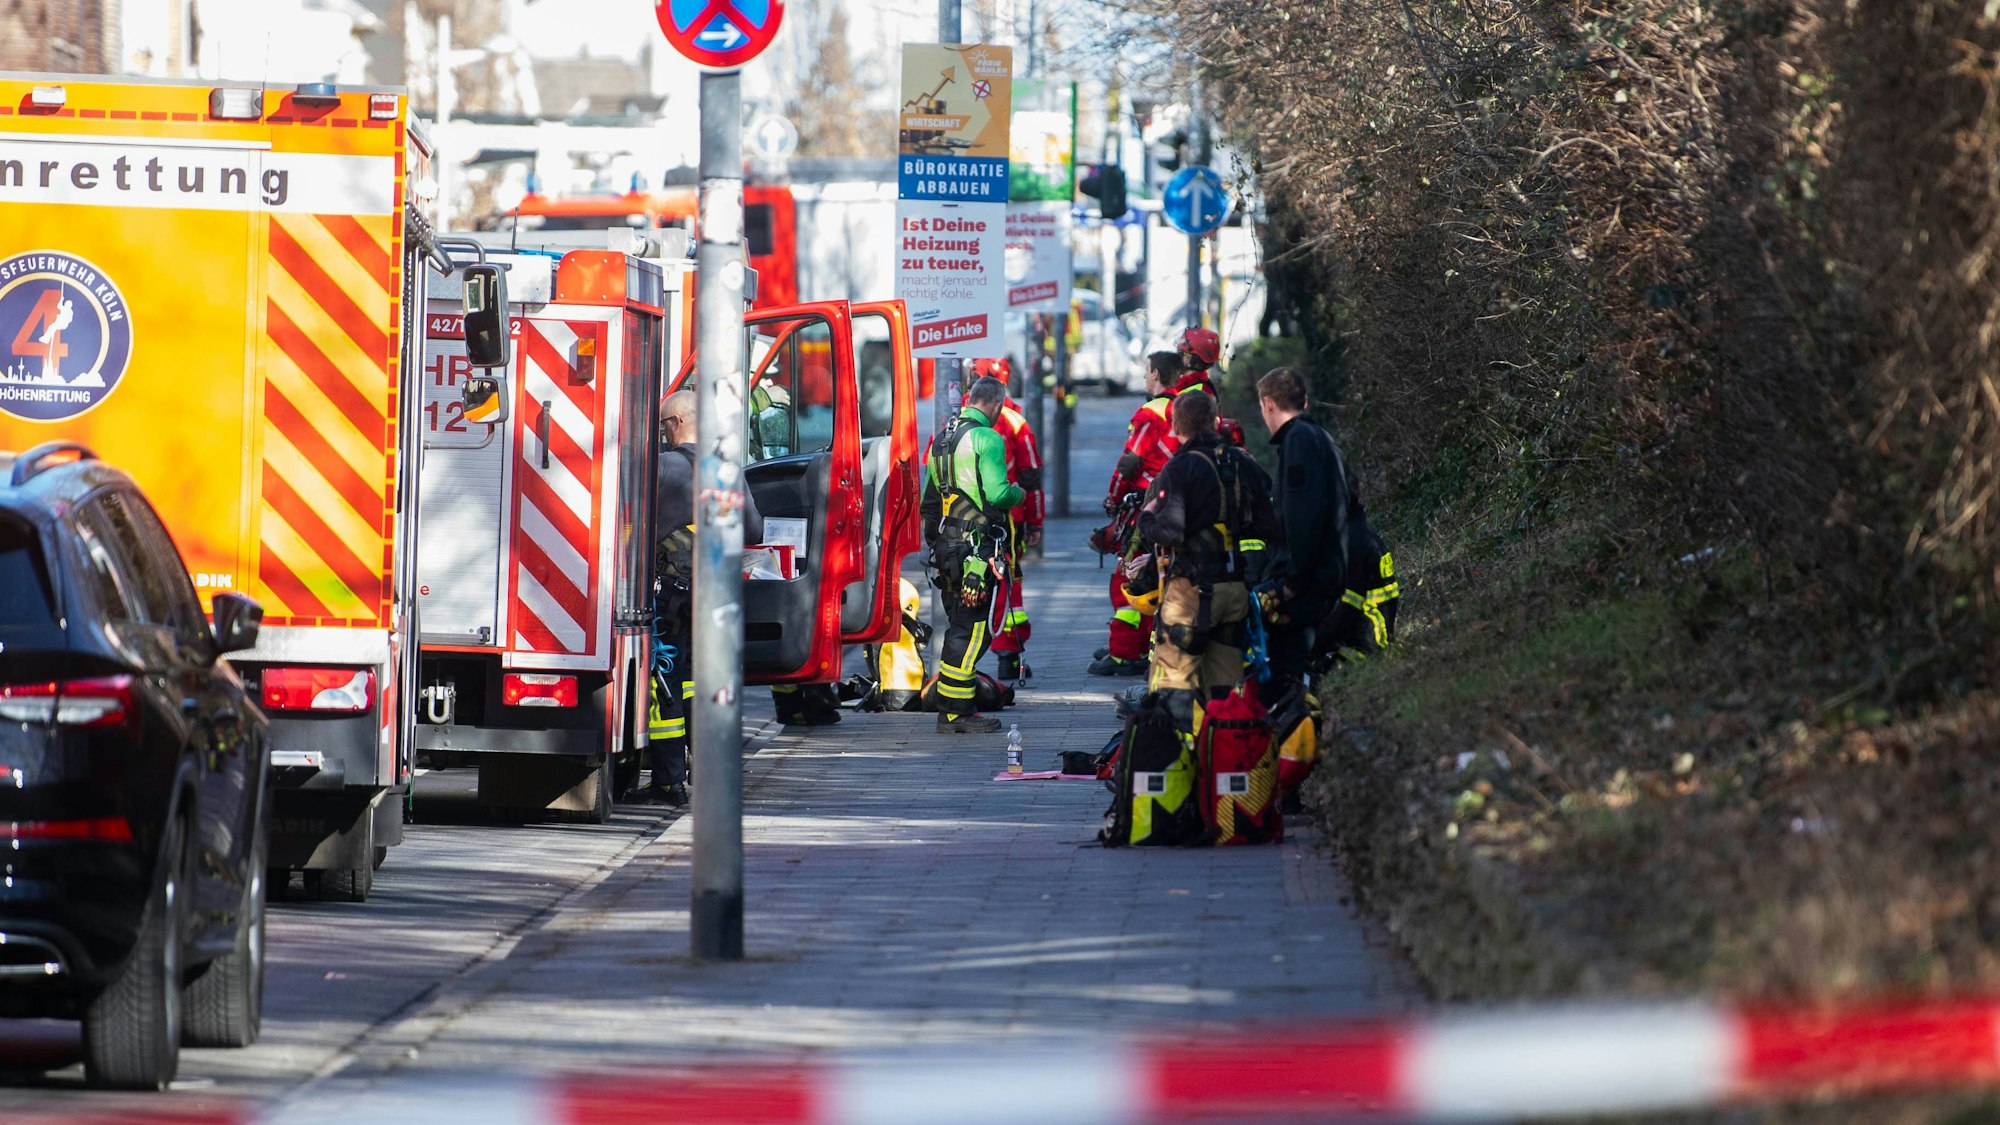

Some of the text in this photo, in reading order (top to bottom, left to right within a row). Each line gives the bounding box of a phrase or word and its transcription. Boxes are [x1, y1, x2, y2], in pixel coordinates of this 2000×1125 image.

[905, 117, 961, 128] WIRTSCHAFT
[904, 159, 1004, 178] BÜROKRATIE
[0, 155, 289, 206] nrettung
[916, 180, 990, 195] ABBAUEN
[902, 217, 987, 232] Ist Deine
[902, 236, 981, 255] Heizung
[902, 256, 985, 273] zu teuer,
[901, 275, 988, 288] macht jemand
[95, 283, 124, 322] KÖLN
[901, 288, 976, 301] richtig Kohle.
[918, 321, 983, 343] Die Linke
[0, 386, 91, 404] HÖHENRETTUNG
